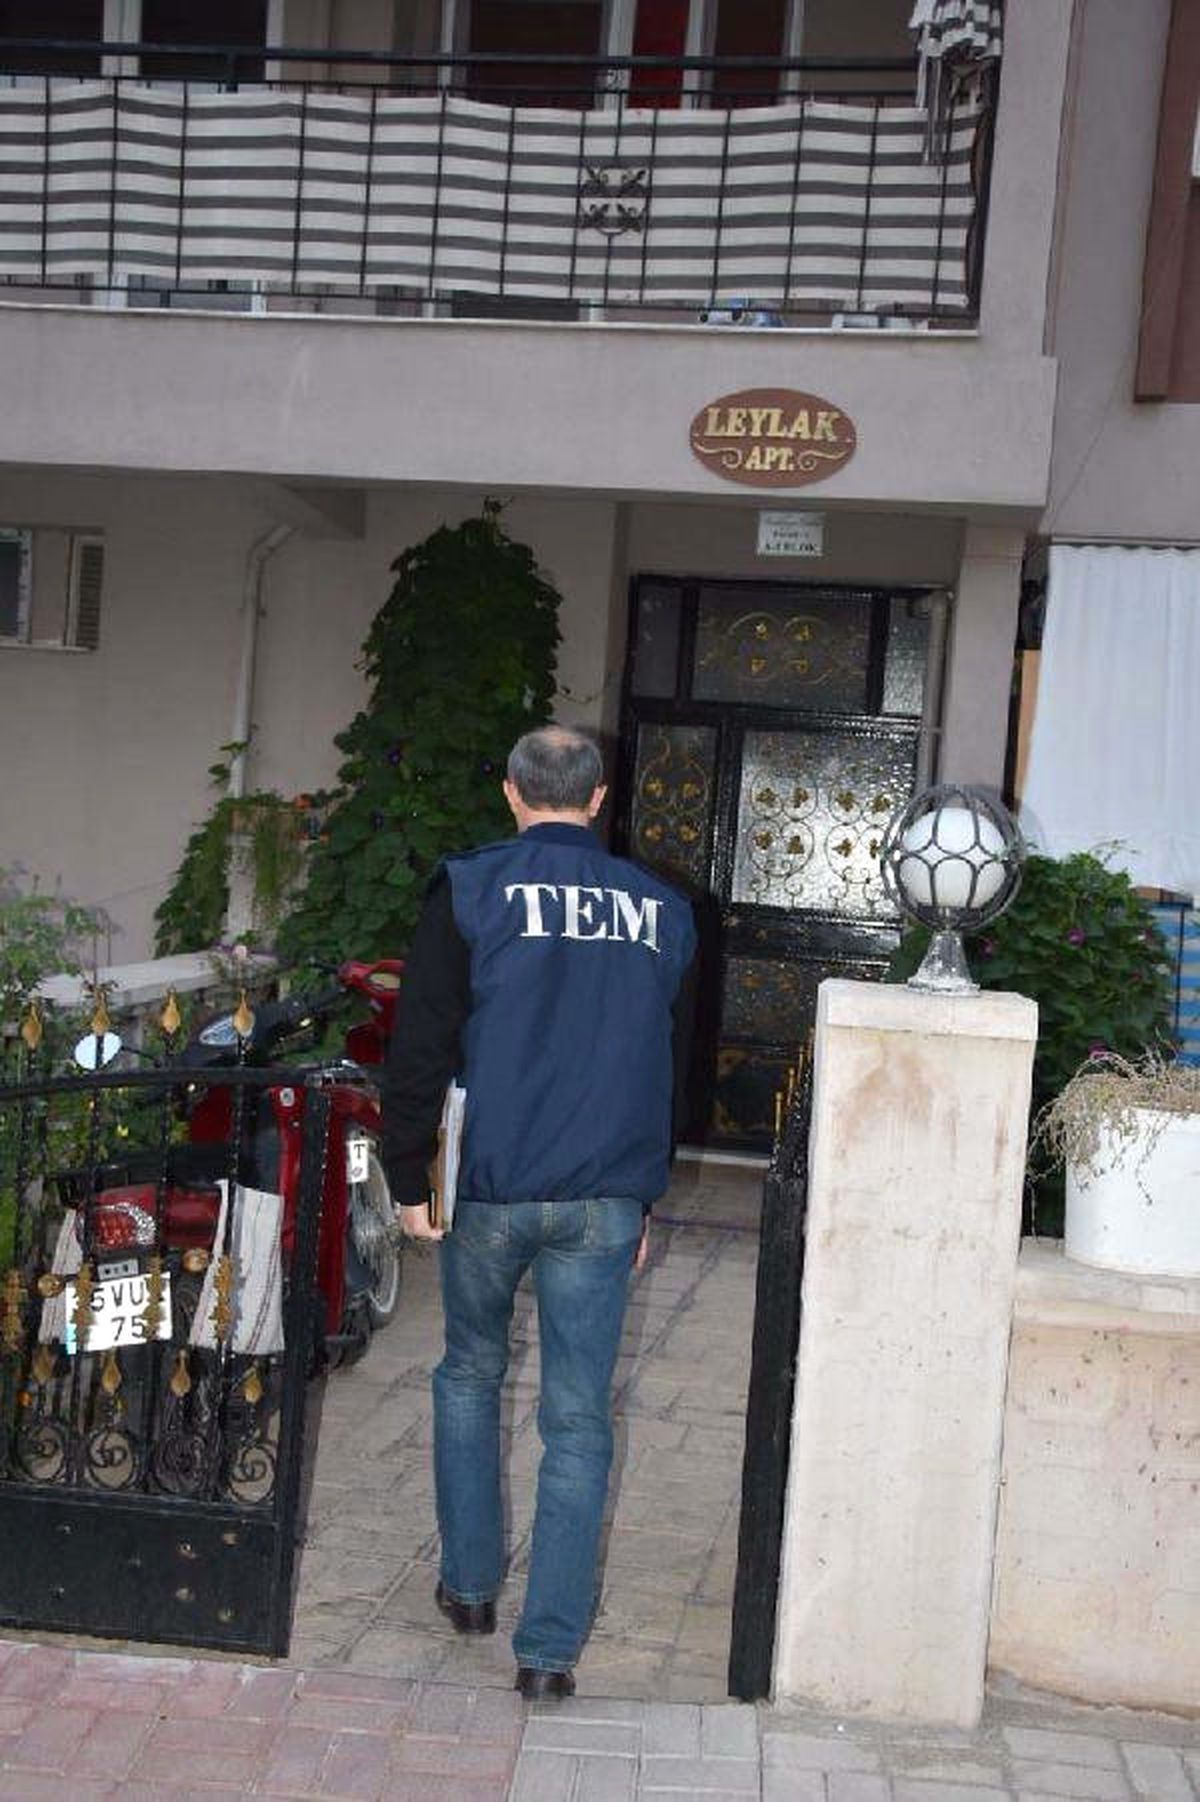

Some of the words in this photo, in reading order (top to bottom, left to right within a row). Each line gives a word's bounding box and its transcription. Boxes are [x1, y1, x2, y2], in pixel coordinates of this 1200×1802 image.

[704, 408, 840, 442] LEYLAK
[744, 446, 795, 471] APT.
[504, 883, 663, 953] TEM
